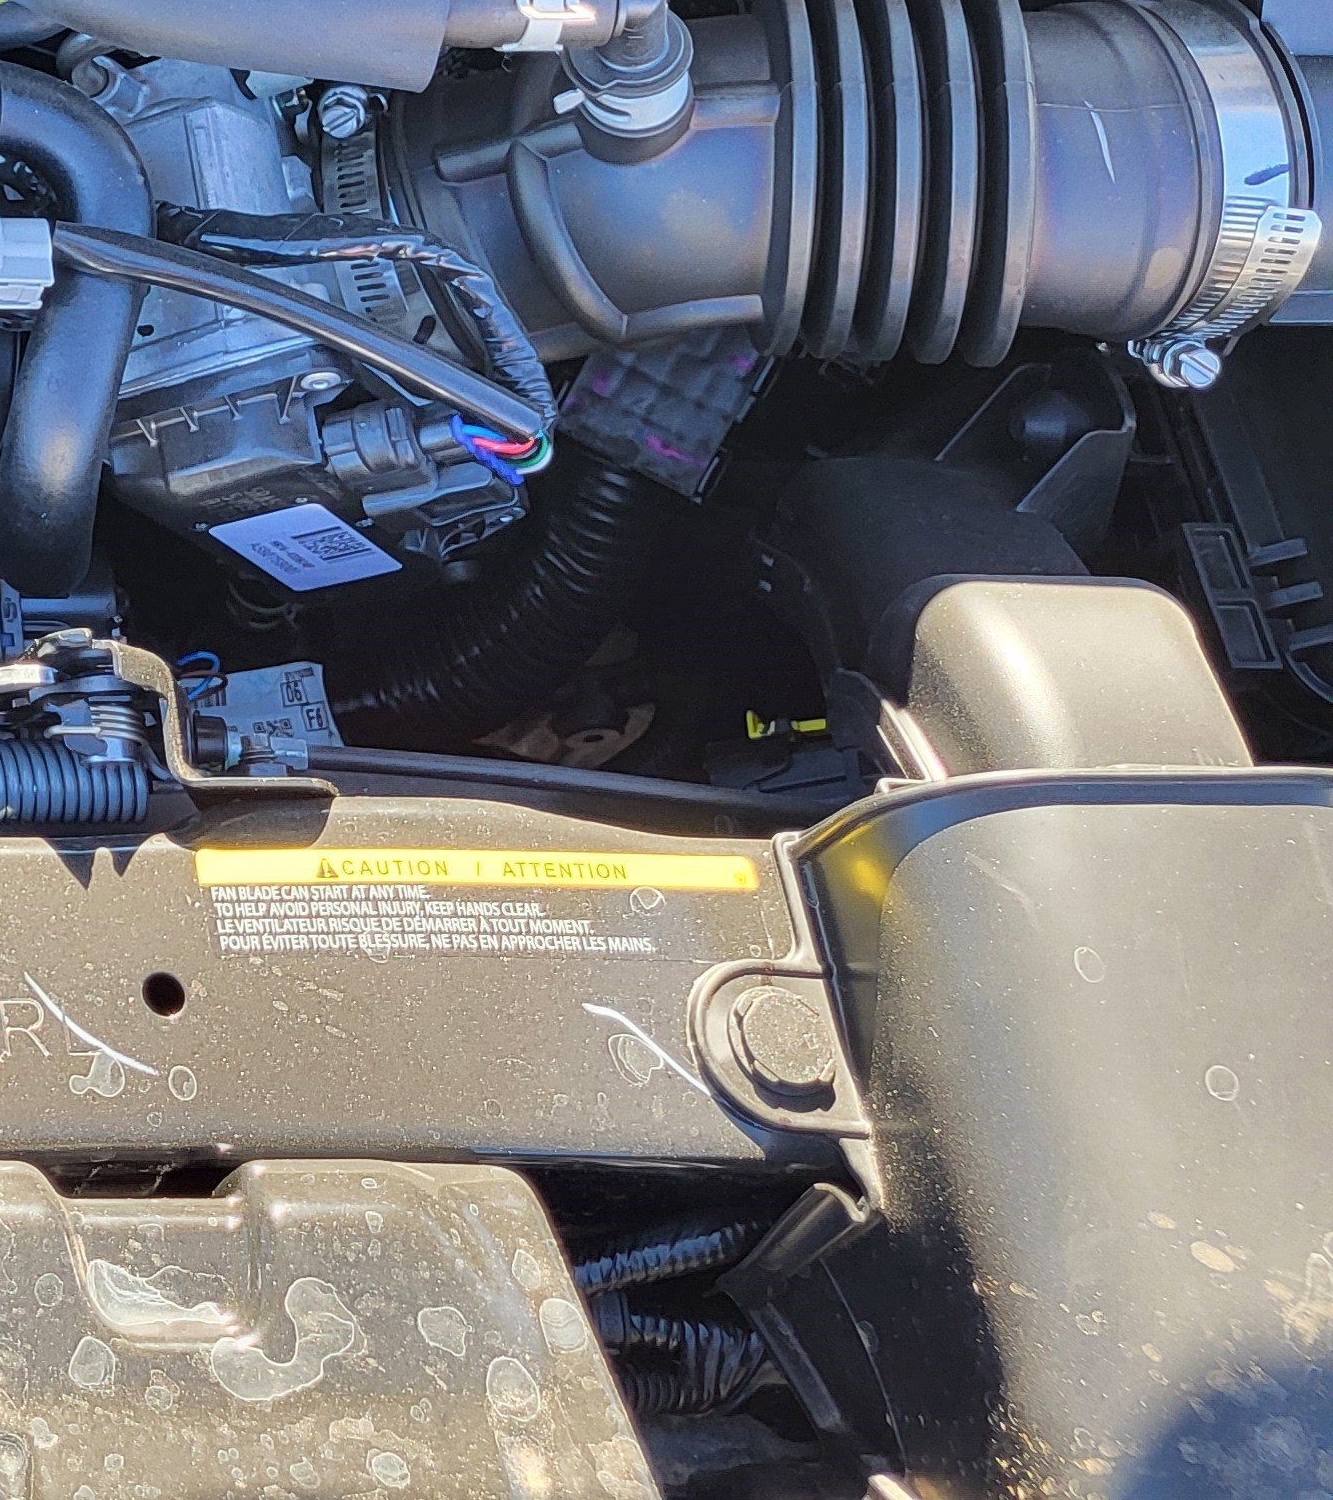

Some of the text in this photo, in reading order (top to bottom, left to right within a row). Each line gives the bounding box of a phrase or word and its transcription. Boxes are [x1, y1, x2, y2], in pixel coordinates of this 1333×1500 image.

[342, 860, 627, 880] CAUTION ATTENTION
[211, 885, 237, 900] FAN
[238, 885, 281, 900] BLADE
[281, 885, 309, 899] CAN
[310, 885, 349, 900] START
[351, 885, 368, 899] AT
[369, 885, 396, 900] ANY
[214, 902, 234, 917] TO
[235, 902, 266, 917] HELP
[269, 902, 309, 917] AVOID
[310, 902, 377, 917] PERSONAL
[378, 902, 425, 918] INJURY,
[425, 902, 455, 916] KEEP
[456, 902, 501, 917] HANDS
[216, 915, 596, 935] LE VENTILATEUR RISQUE DE DÉMARRER À TOUT MOMENT.
[219, 932, 657, 954] POUR ÉVITER TOUTE BLESSURE, NE PAS EN APPROCHER LES MAINS.
